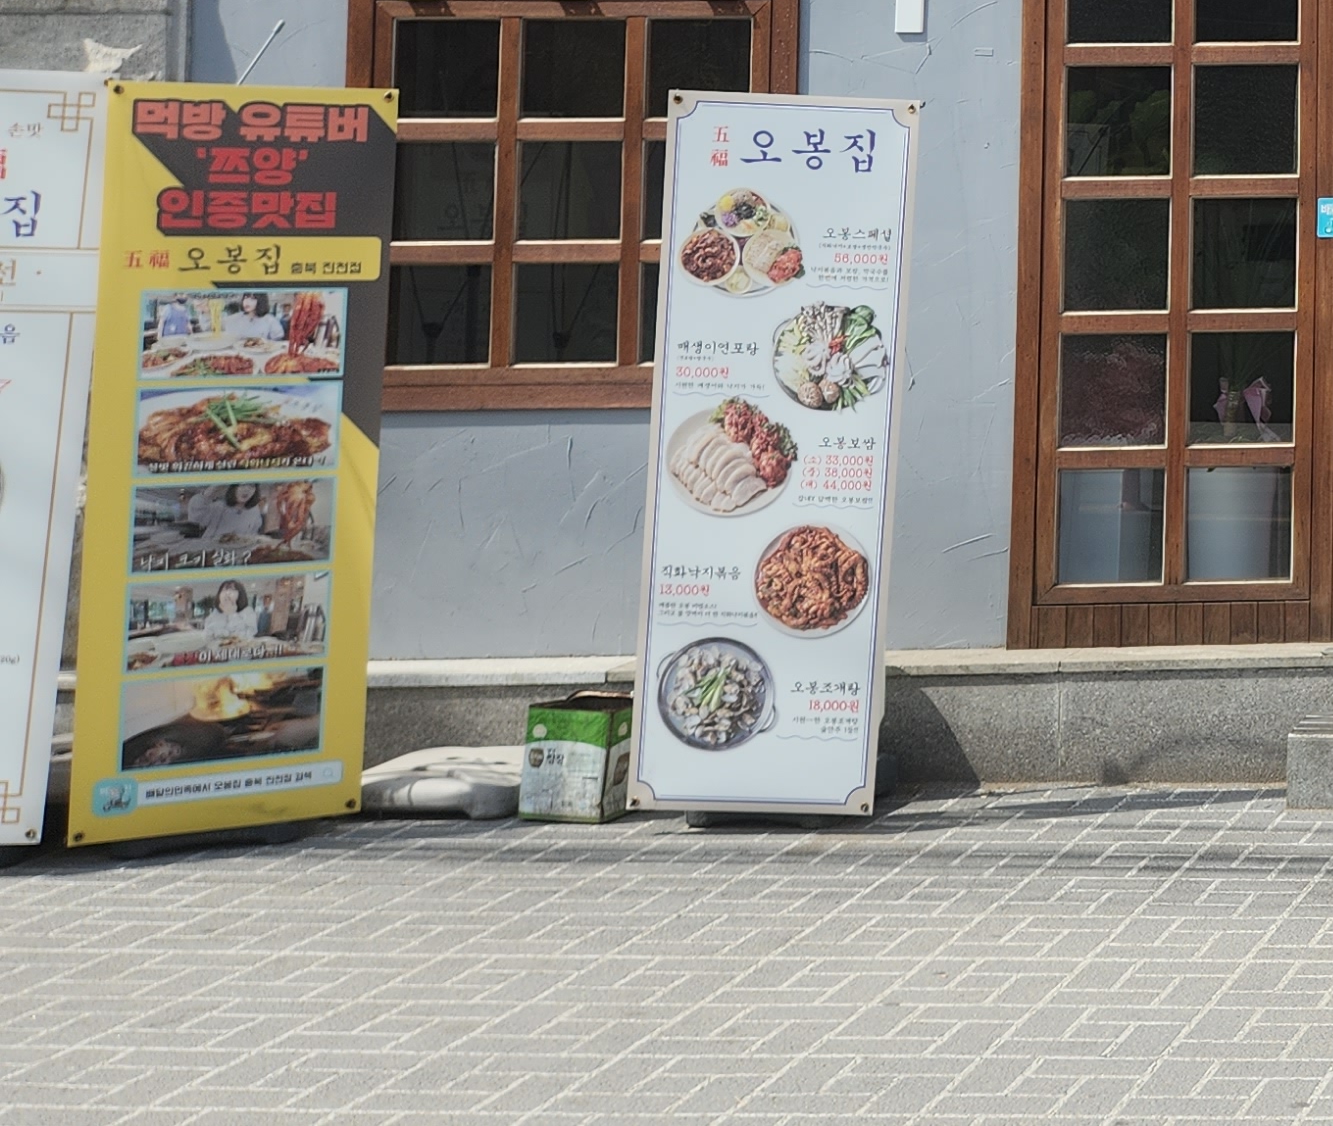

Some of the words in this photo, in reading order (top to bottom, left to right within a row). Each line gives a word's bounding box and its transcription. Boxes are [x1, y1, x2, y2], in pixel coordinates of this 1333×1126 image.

[134, 100, 226, 141] 먹방
[239, 102, 369, 142] 유튜버
[740, 128, 876, 173] 오봉집
[196, 147, 309, 186] '쯔양'
[158, 189, 337, 229] 인증맛집
[178, 244, 282, 275] 오봉집
[677, 340, 759, 356] 매생이연포탕
[818, 436, 876, 451] 오봉보쌈
[661, 564, 742, 581] 직화낙지볶음
[791, 682, 861, 696] 오봉조개탕
